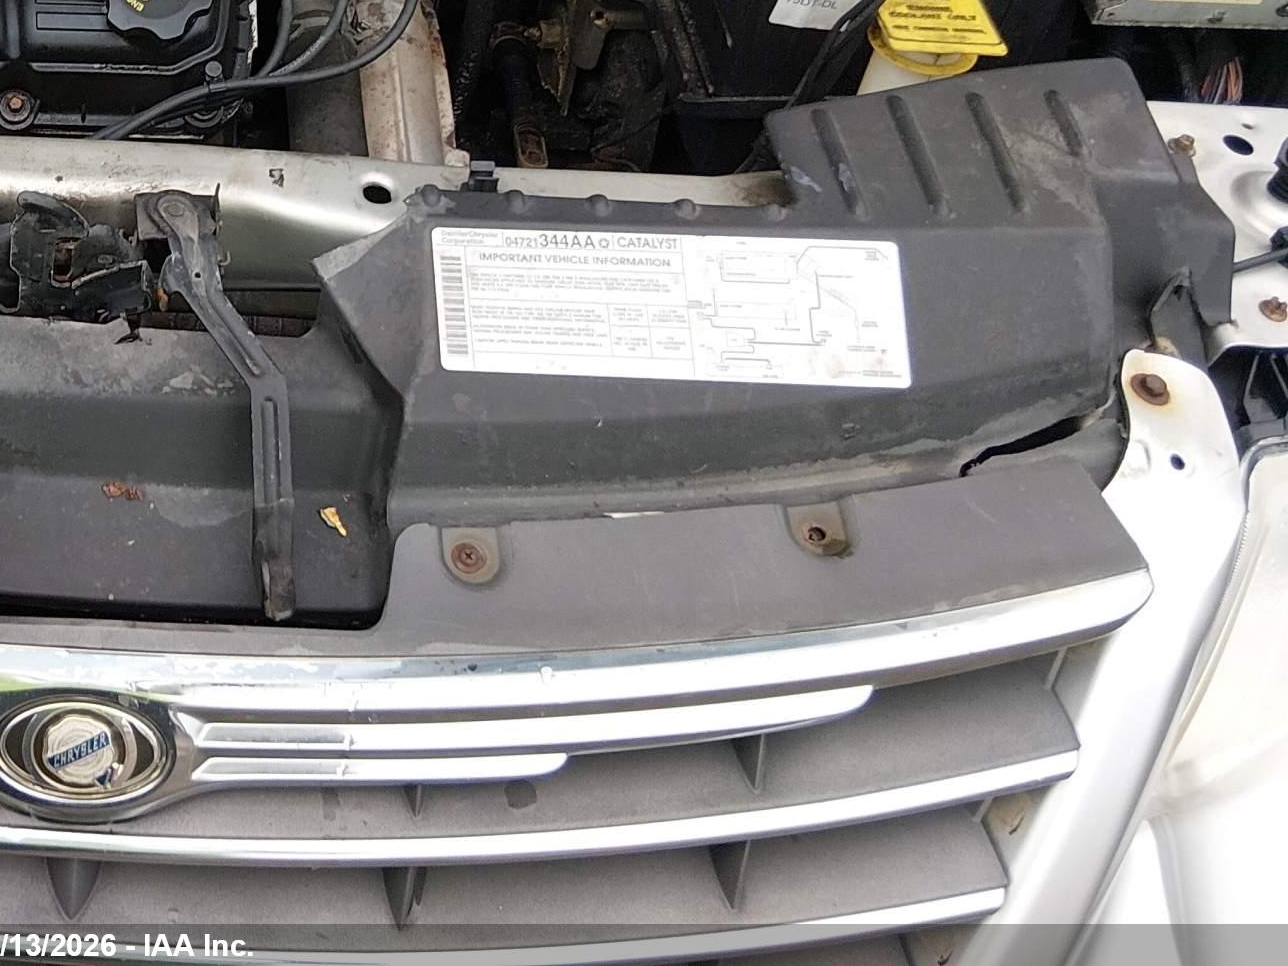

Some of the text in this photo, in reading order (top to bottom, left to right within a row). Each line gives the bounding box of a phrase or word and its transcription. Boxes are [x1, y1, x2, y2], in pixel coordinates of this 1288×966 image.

[504, 233, 596, 249] 04721344AA
[616, 236, 678, 250] CATALYST
[479, 252, 671, 268] IMPORTANT VEHICLE INFORMATION
[53, 732, 108, 768] CHRYSLER
